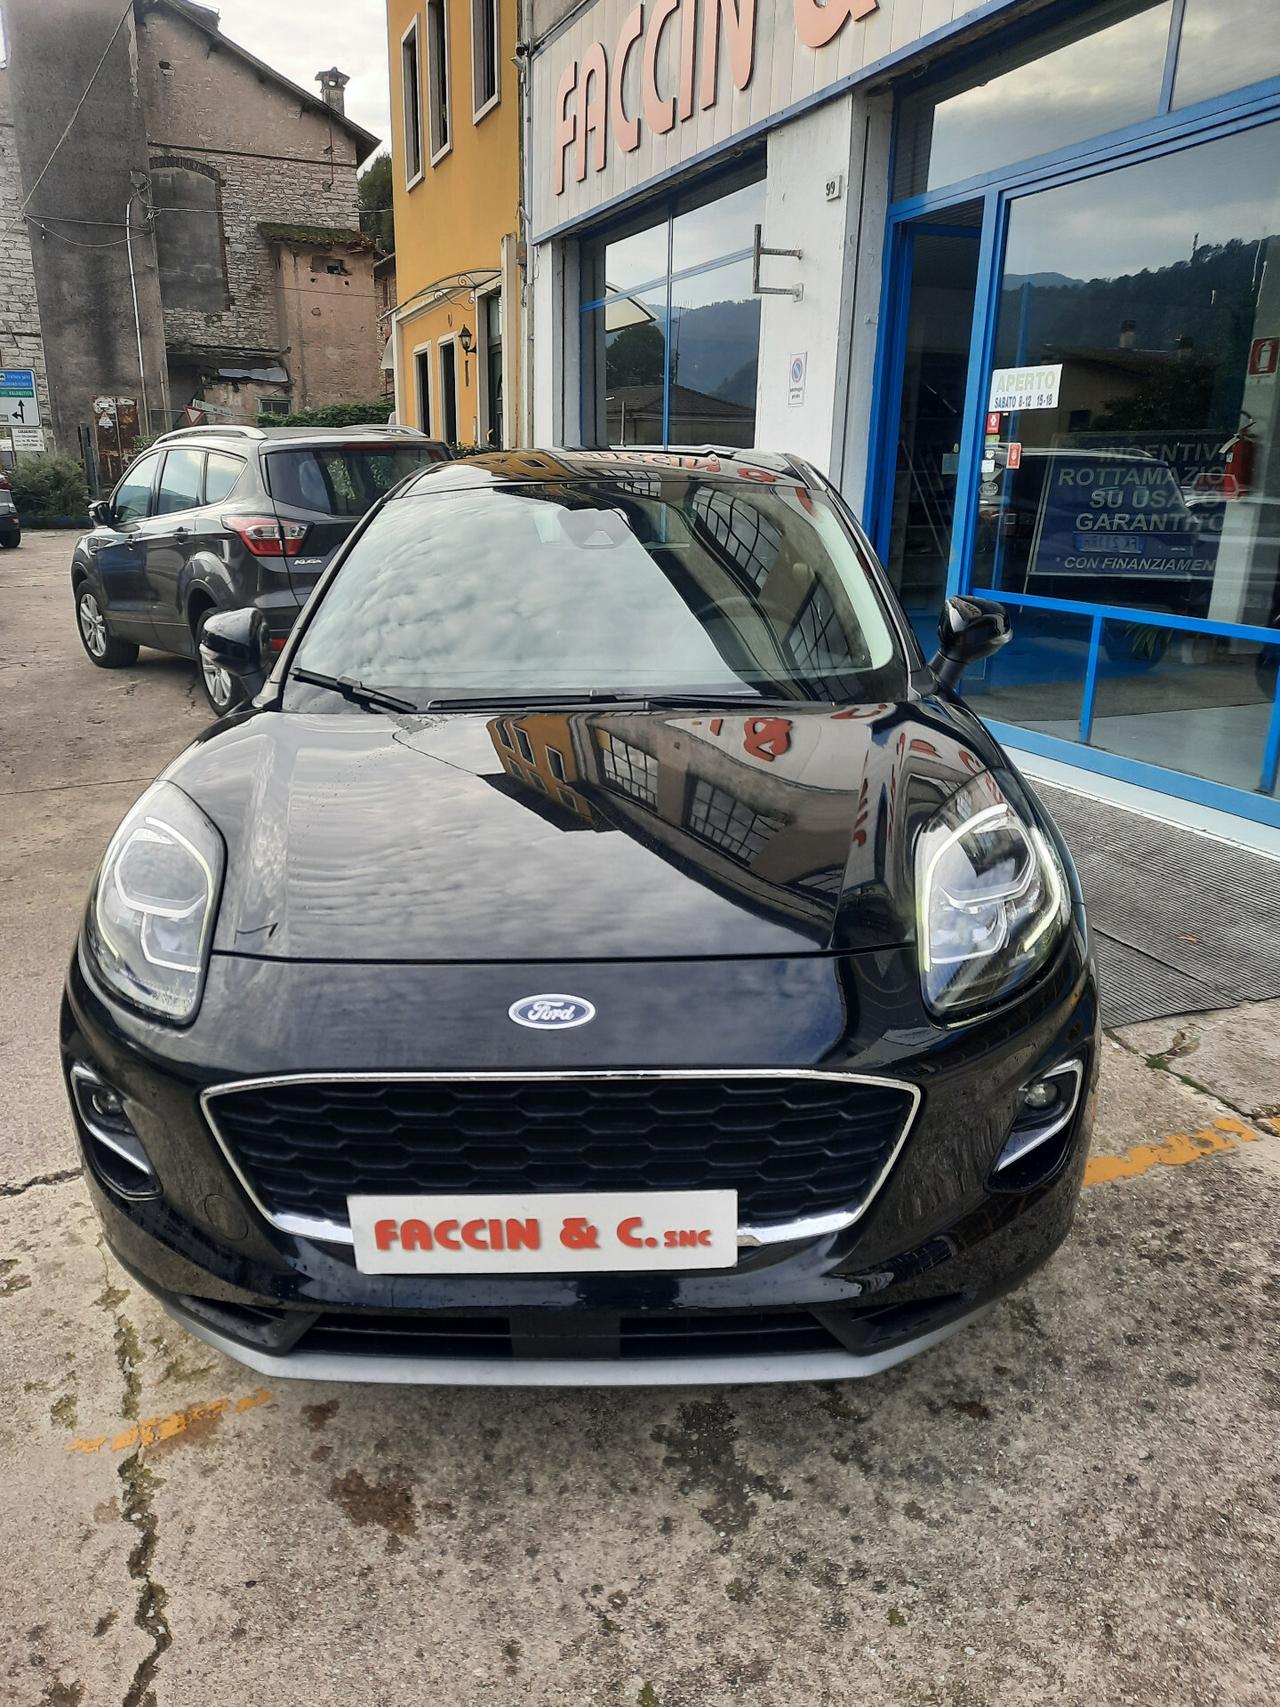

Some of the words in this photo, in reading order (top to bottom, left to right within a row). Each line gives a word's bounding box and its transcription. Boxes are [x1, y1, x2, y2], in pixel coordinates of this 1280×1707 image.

[554, 0, 758, 196] FACCIN
[825, 181, 836, 196] 99
[997, 370, 1056, 393] APERTO
[995, 396, 1017, 408] SABATO
[1089, 489, 1123, 508] SU
[1132, 489, 1218, 509] USAO
[1064, 557, 1099, 569] CON
[527, 1000, 575, 1022] Ford
[374, 1217, 541, 1251] FACCIN
[559, 1217, 600, 1250] &
[616, 1216, 659, 1249] C.
